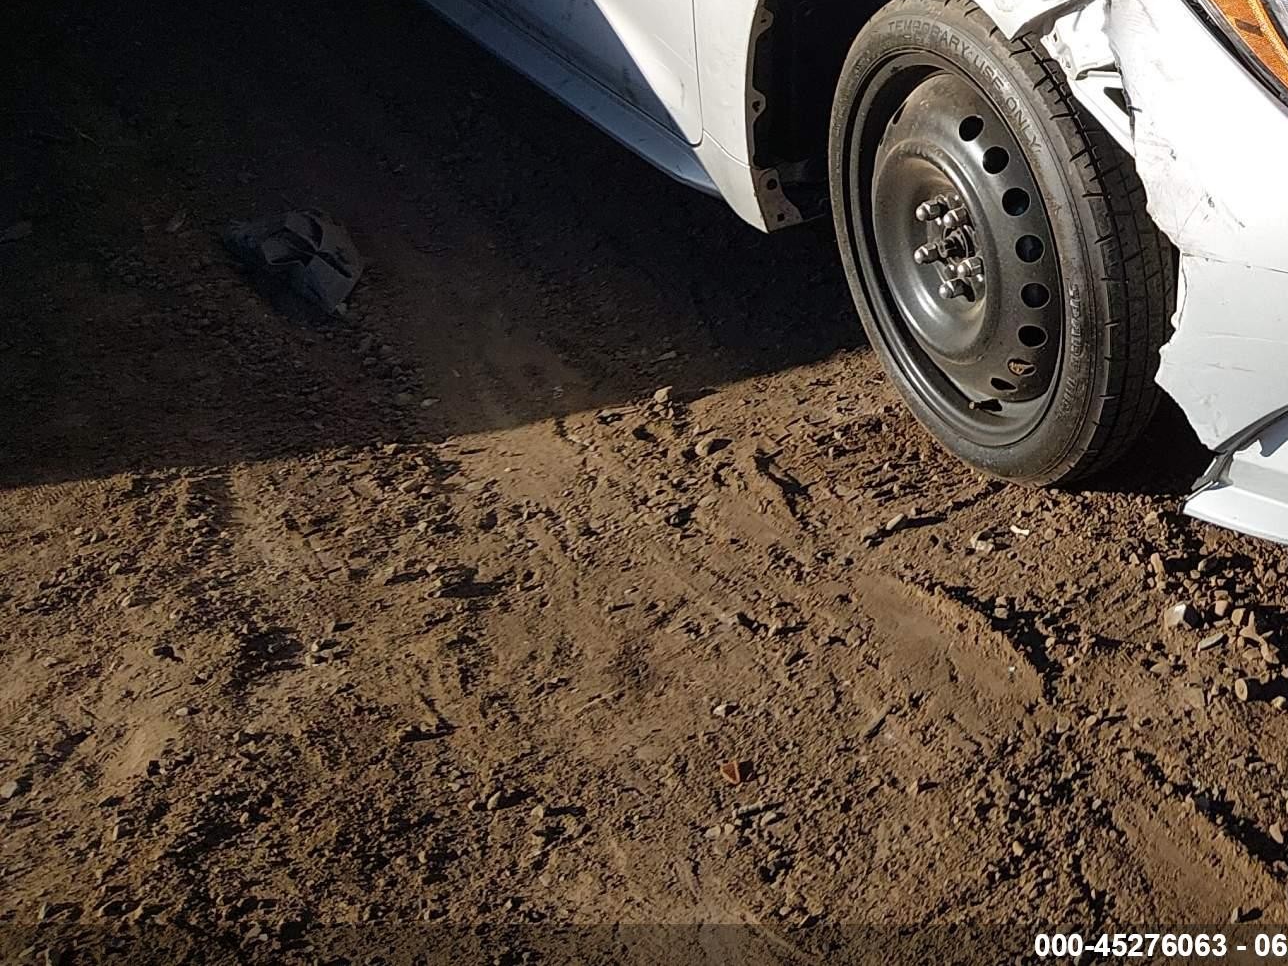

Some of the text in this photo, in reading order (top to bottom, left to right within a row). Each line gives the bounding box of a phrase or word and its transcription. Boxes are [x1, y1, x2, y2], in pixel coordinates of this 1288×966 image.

[887, 18, 1042, 152] TEMPORARY USE ONLY
